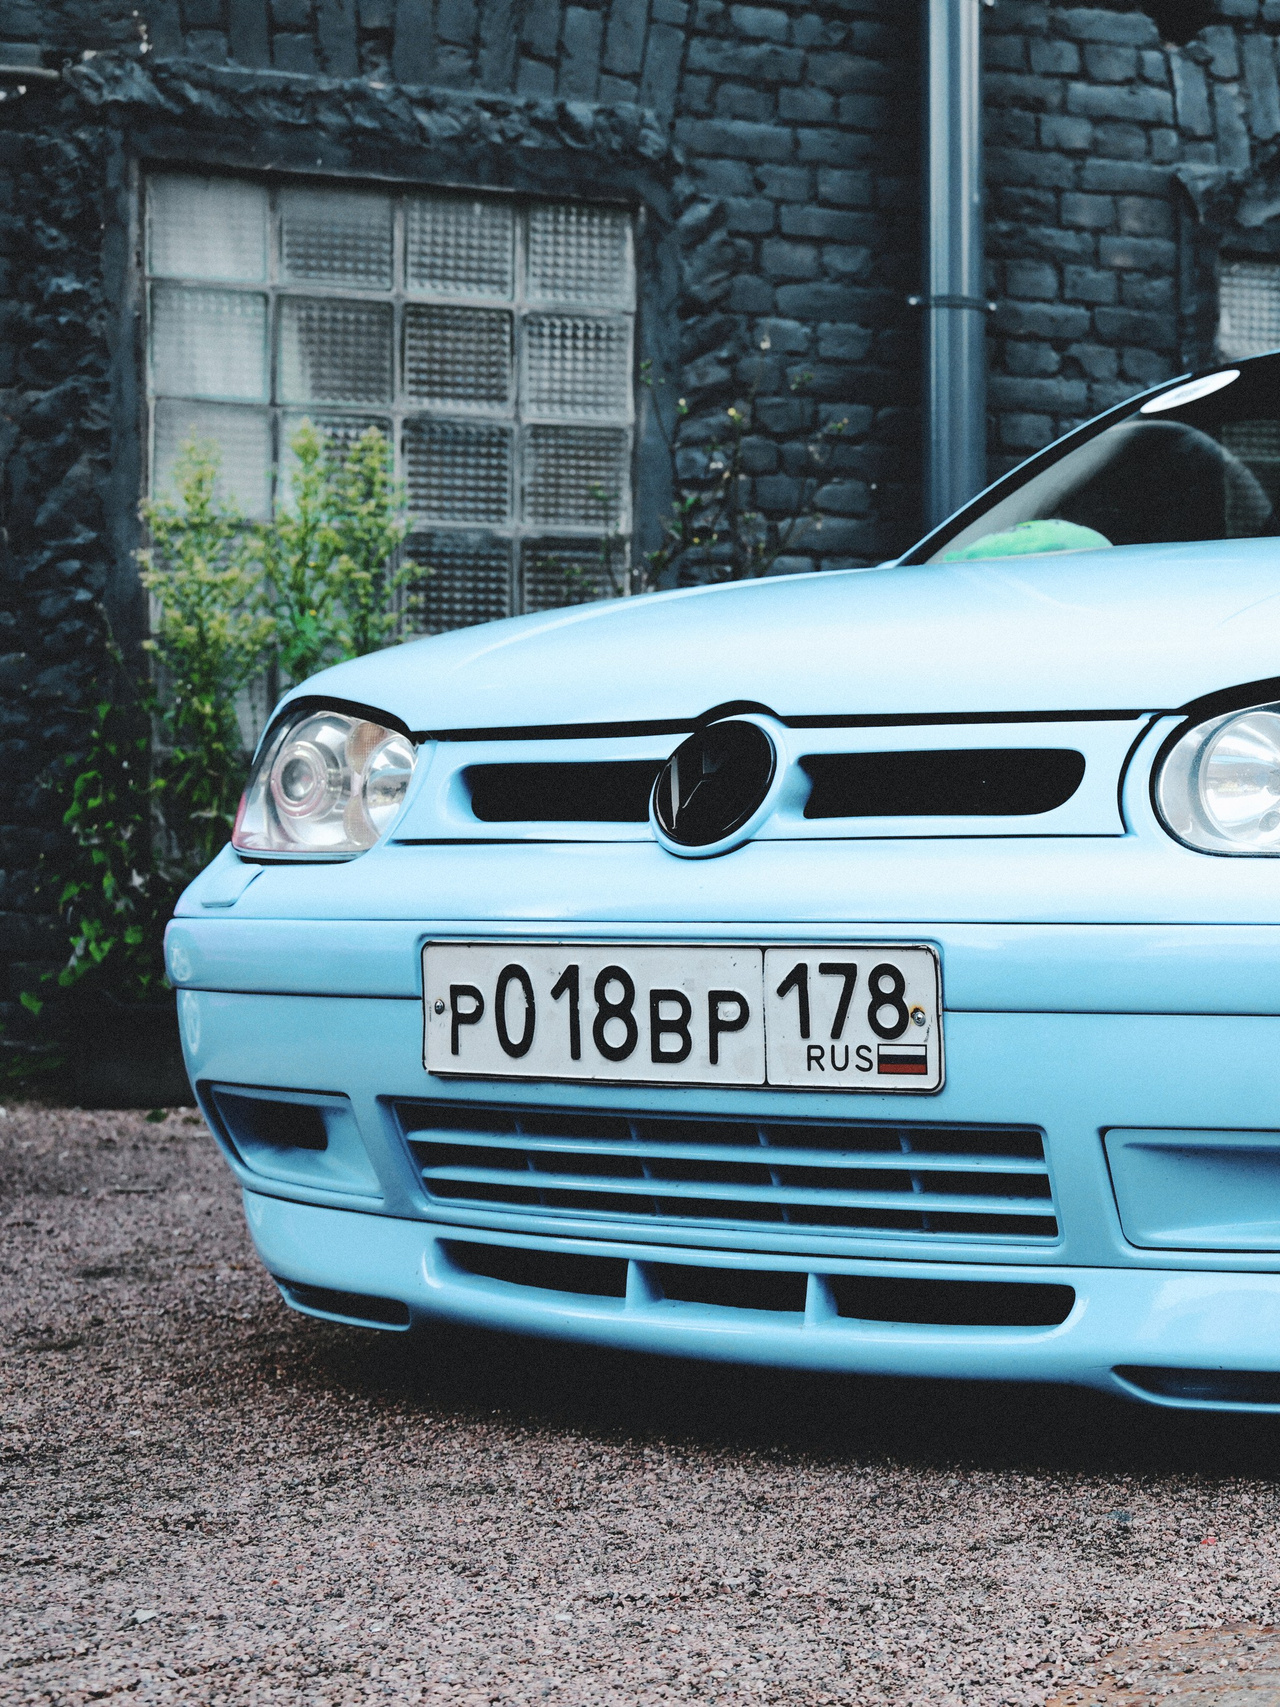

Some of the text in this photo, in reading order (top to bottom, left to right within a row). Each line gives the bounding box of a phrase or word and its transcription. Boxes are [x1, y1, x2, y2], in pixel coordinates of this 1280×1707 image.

[449, 962, 910, 1066] P018BP 178
[807, 1044, 874, 1072] RUS
